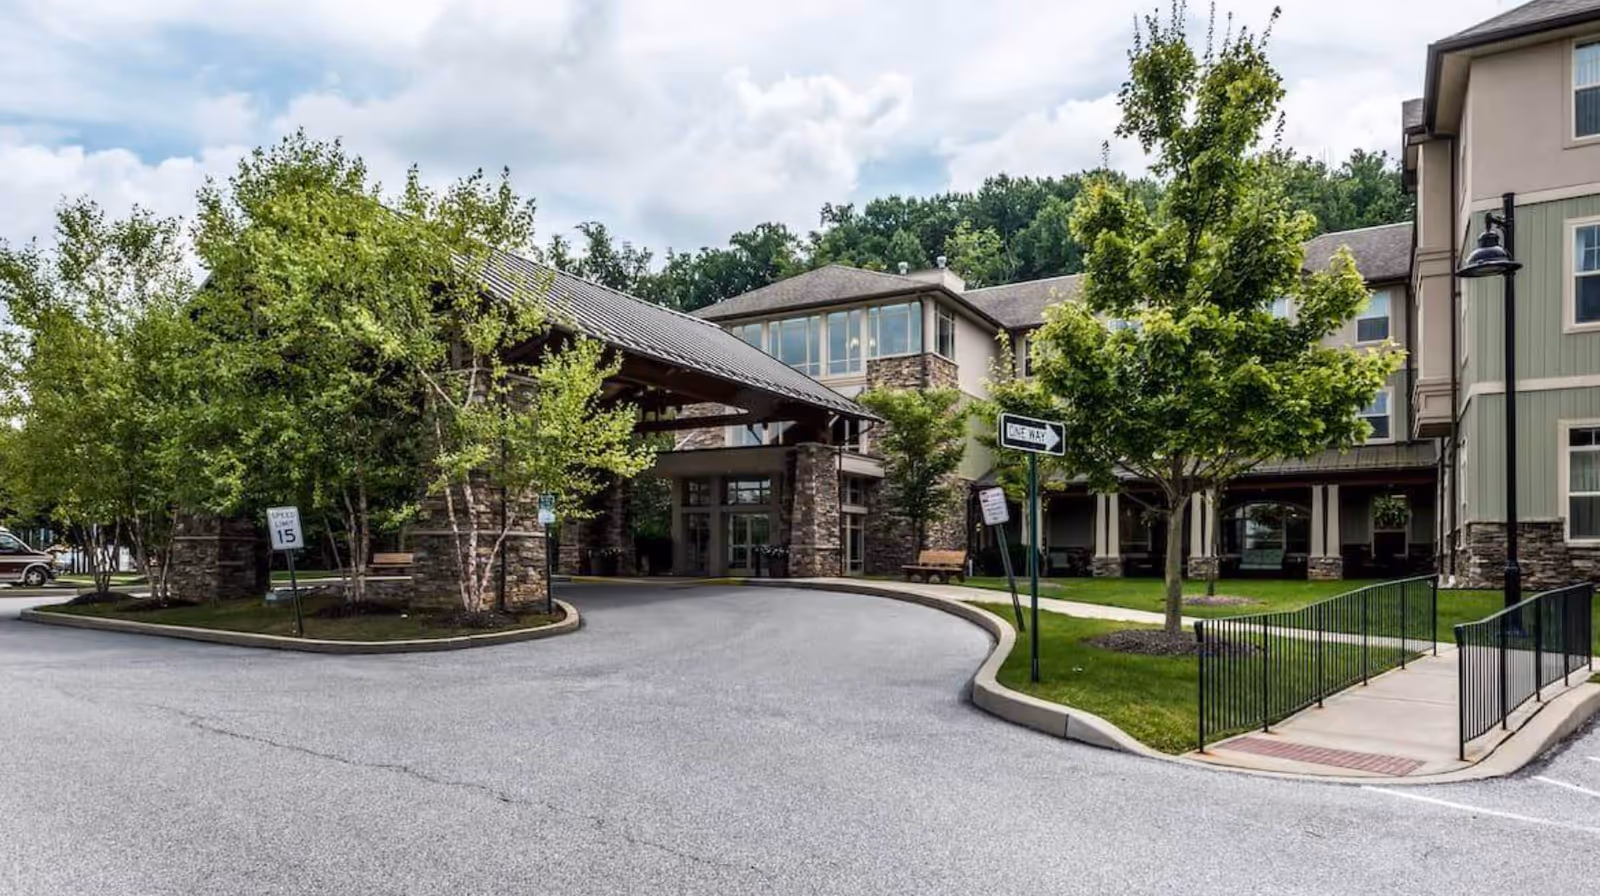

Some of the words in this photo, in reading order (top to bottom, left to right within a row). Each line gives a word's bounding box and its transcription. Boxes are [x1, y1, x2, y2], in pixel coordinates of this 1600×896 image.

[1008, 424, 1026, 439] ONE
[1029, 429, 1046, 442] WAY
[272, 511, 295, 519] SPEED
[274, 520, 293, 528] LIMIT
[278, 528, 296, 544] 15
